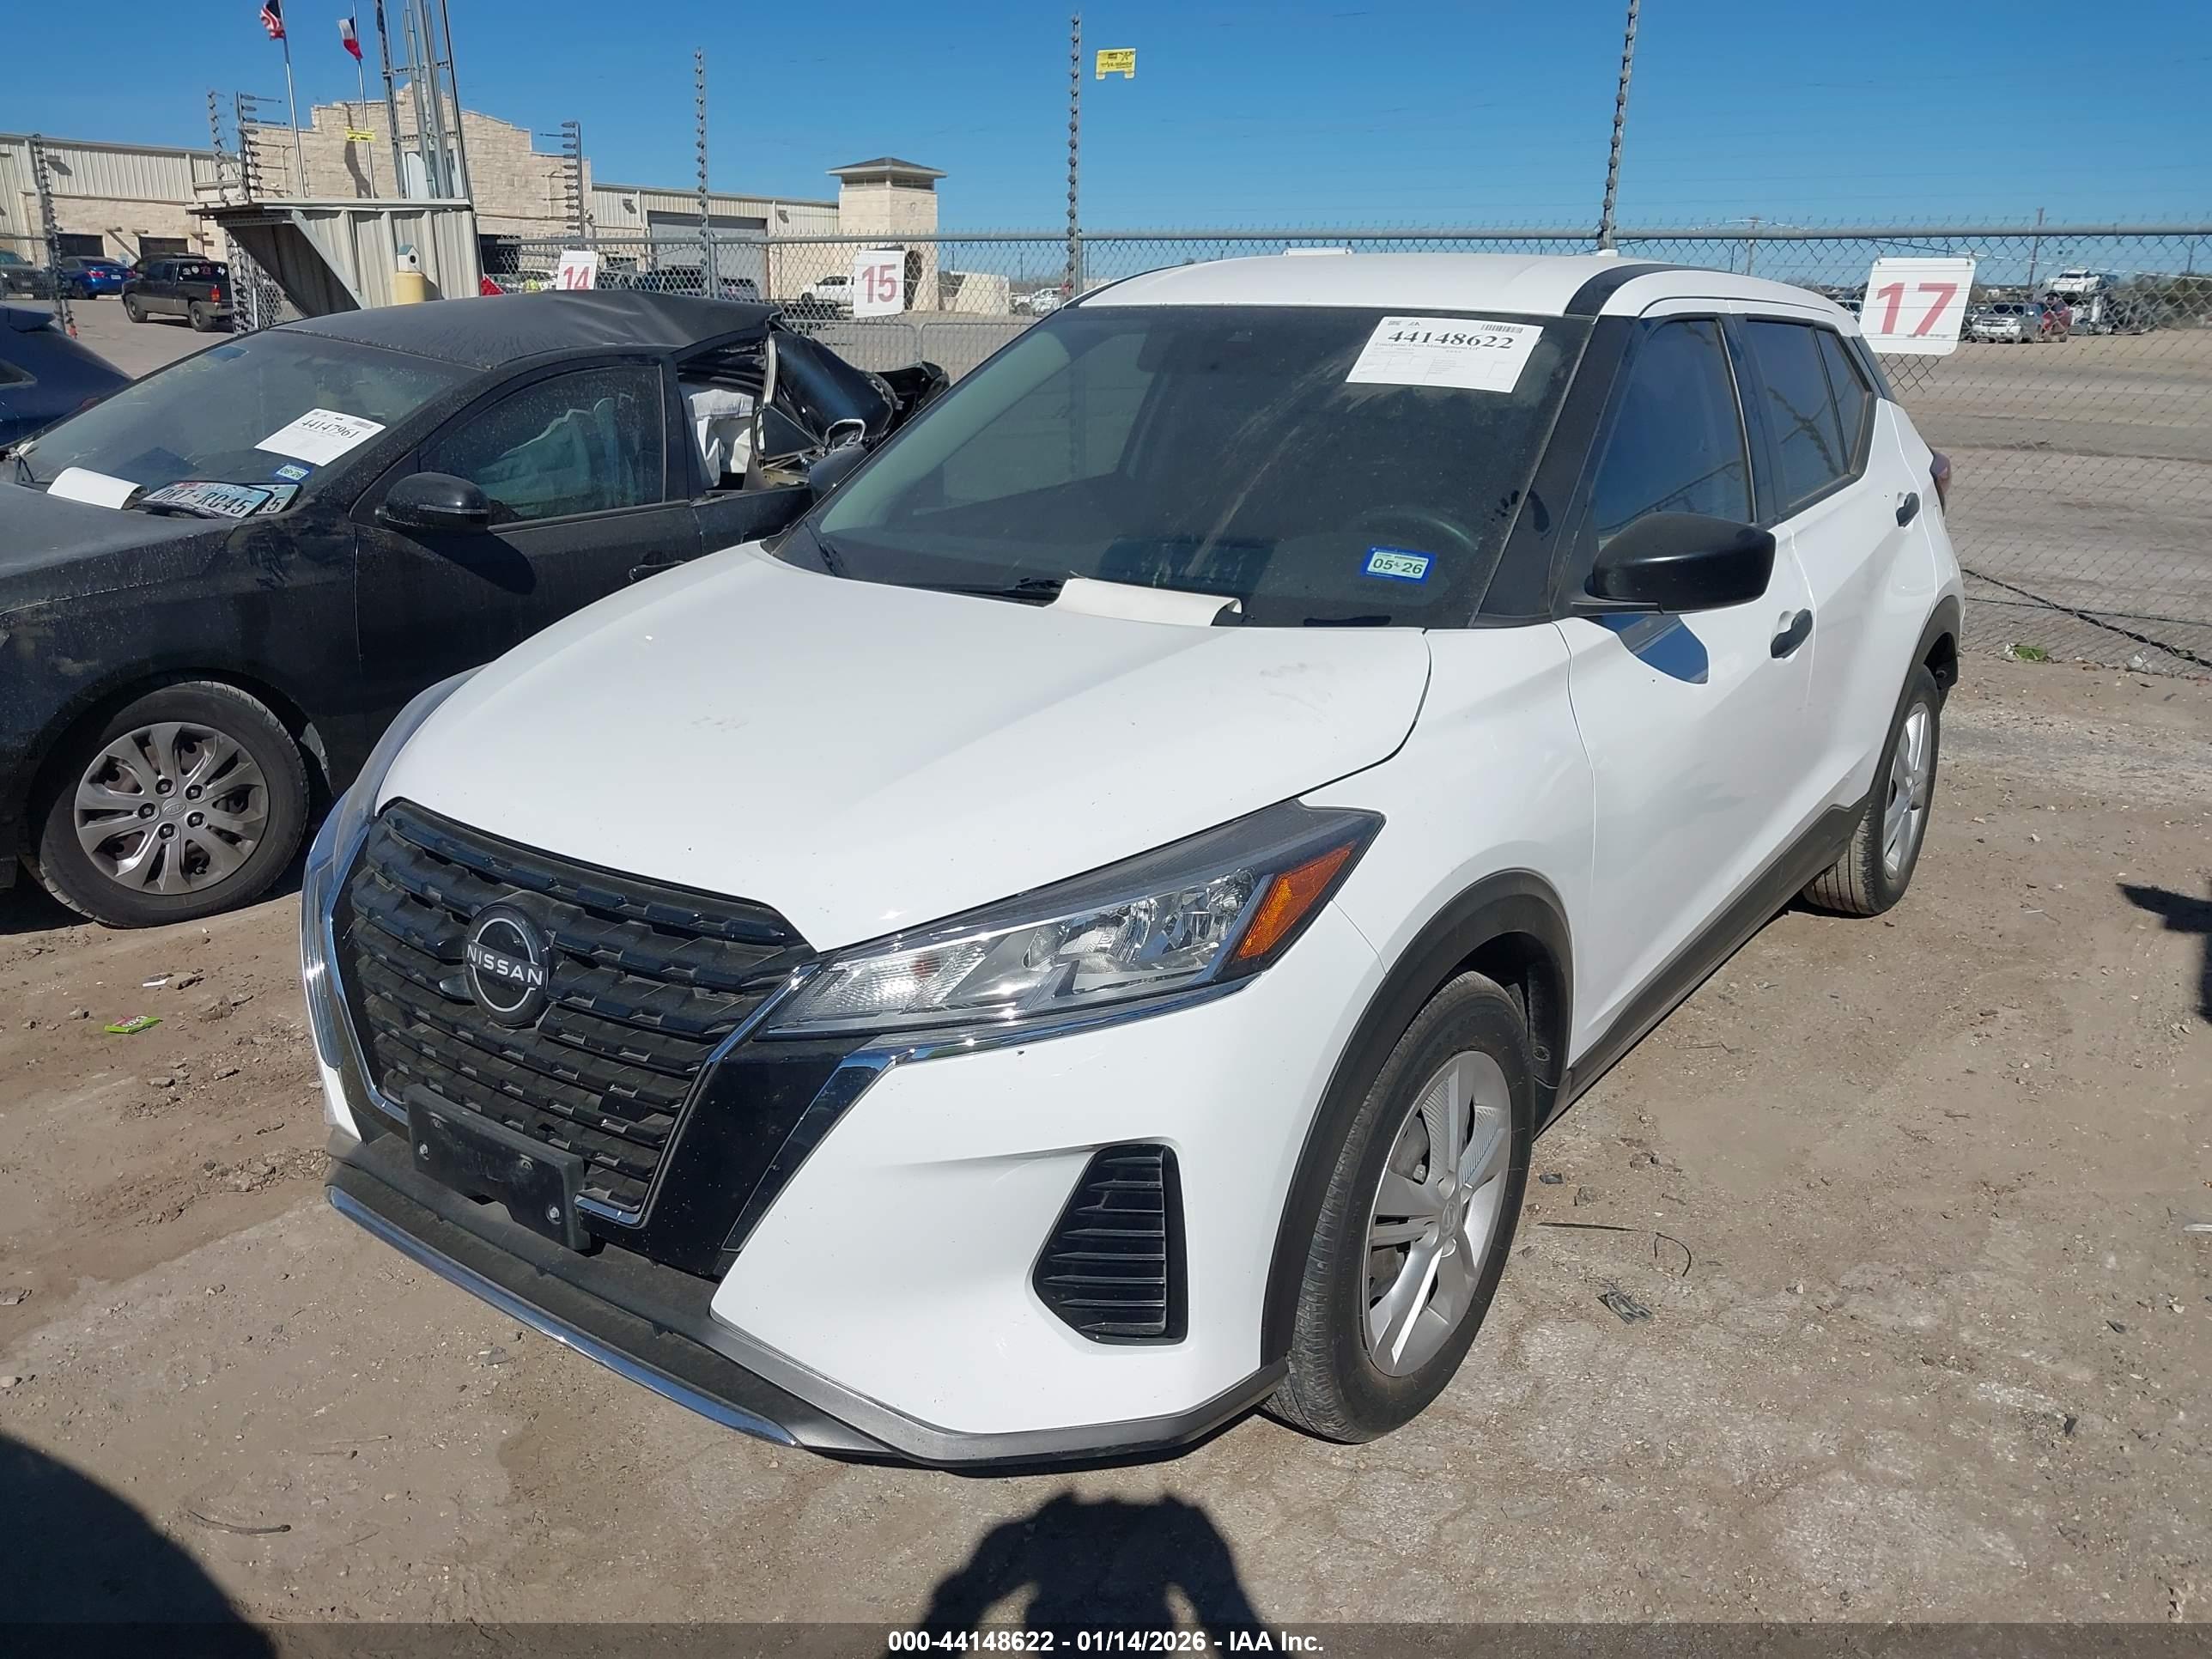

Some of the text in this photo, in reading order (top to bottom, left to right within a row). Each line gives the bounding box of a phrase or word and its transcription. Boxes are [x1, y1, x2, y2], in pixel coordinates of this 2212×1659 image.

[563, 266, 590, 290] 14
[861, 264, 896, 303] 15
[1876, 282, 1959, 336] 17
[1387, 330, 1515, 349] 44148622
[301, 419, 361, 439] 44147961
[1401, 562, 1424, 574] 26
[466, 944, 544, 986] NISSAN
